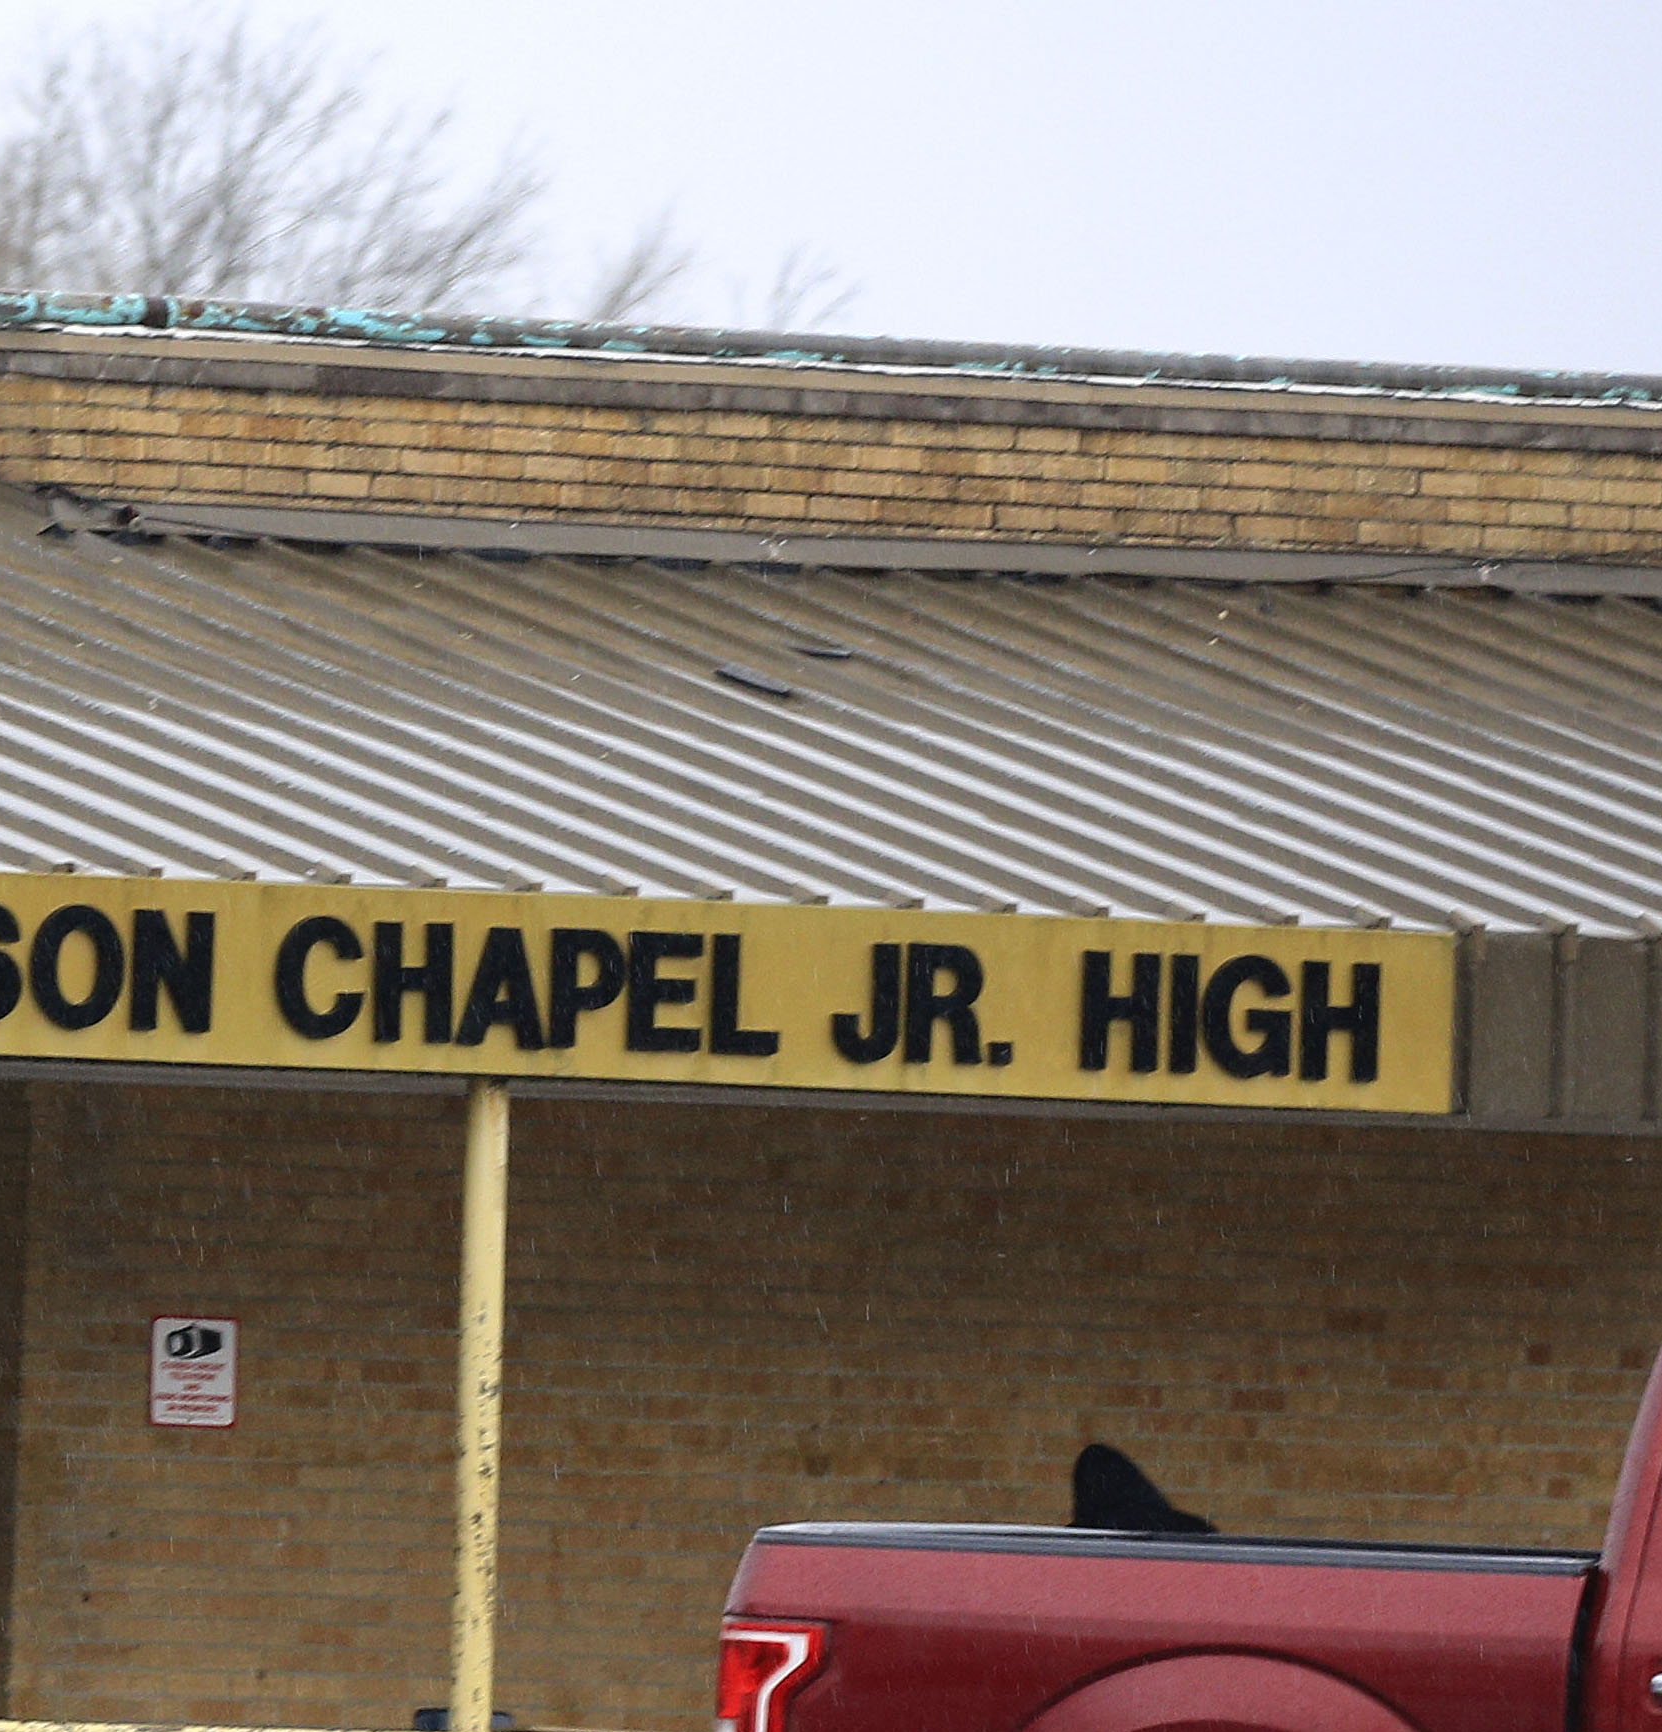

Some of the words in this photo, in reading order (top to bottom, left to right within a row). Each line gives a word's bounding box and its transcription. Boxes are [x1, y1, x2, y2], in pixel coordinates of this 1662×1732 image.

[273, 914, 781, 1059] CHAPEL
[830, 941, 1014, 1067] JR.
[1078, 949, 1383, 1085] HIGH
